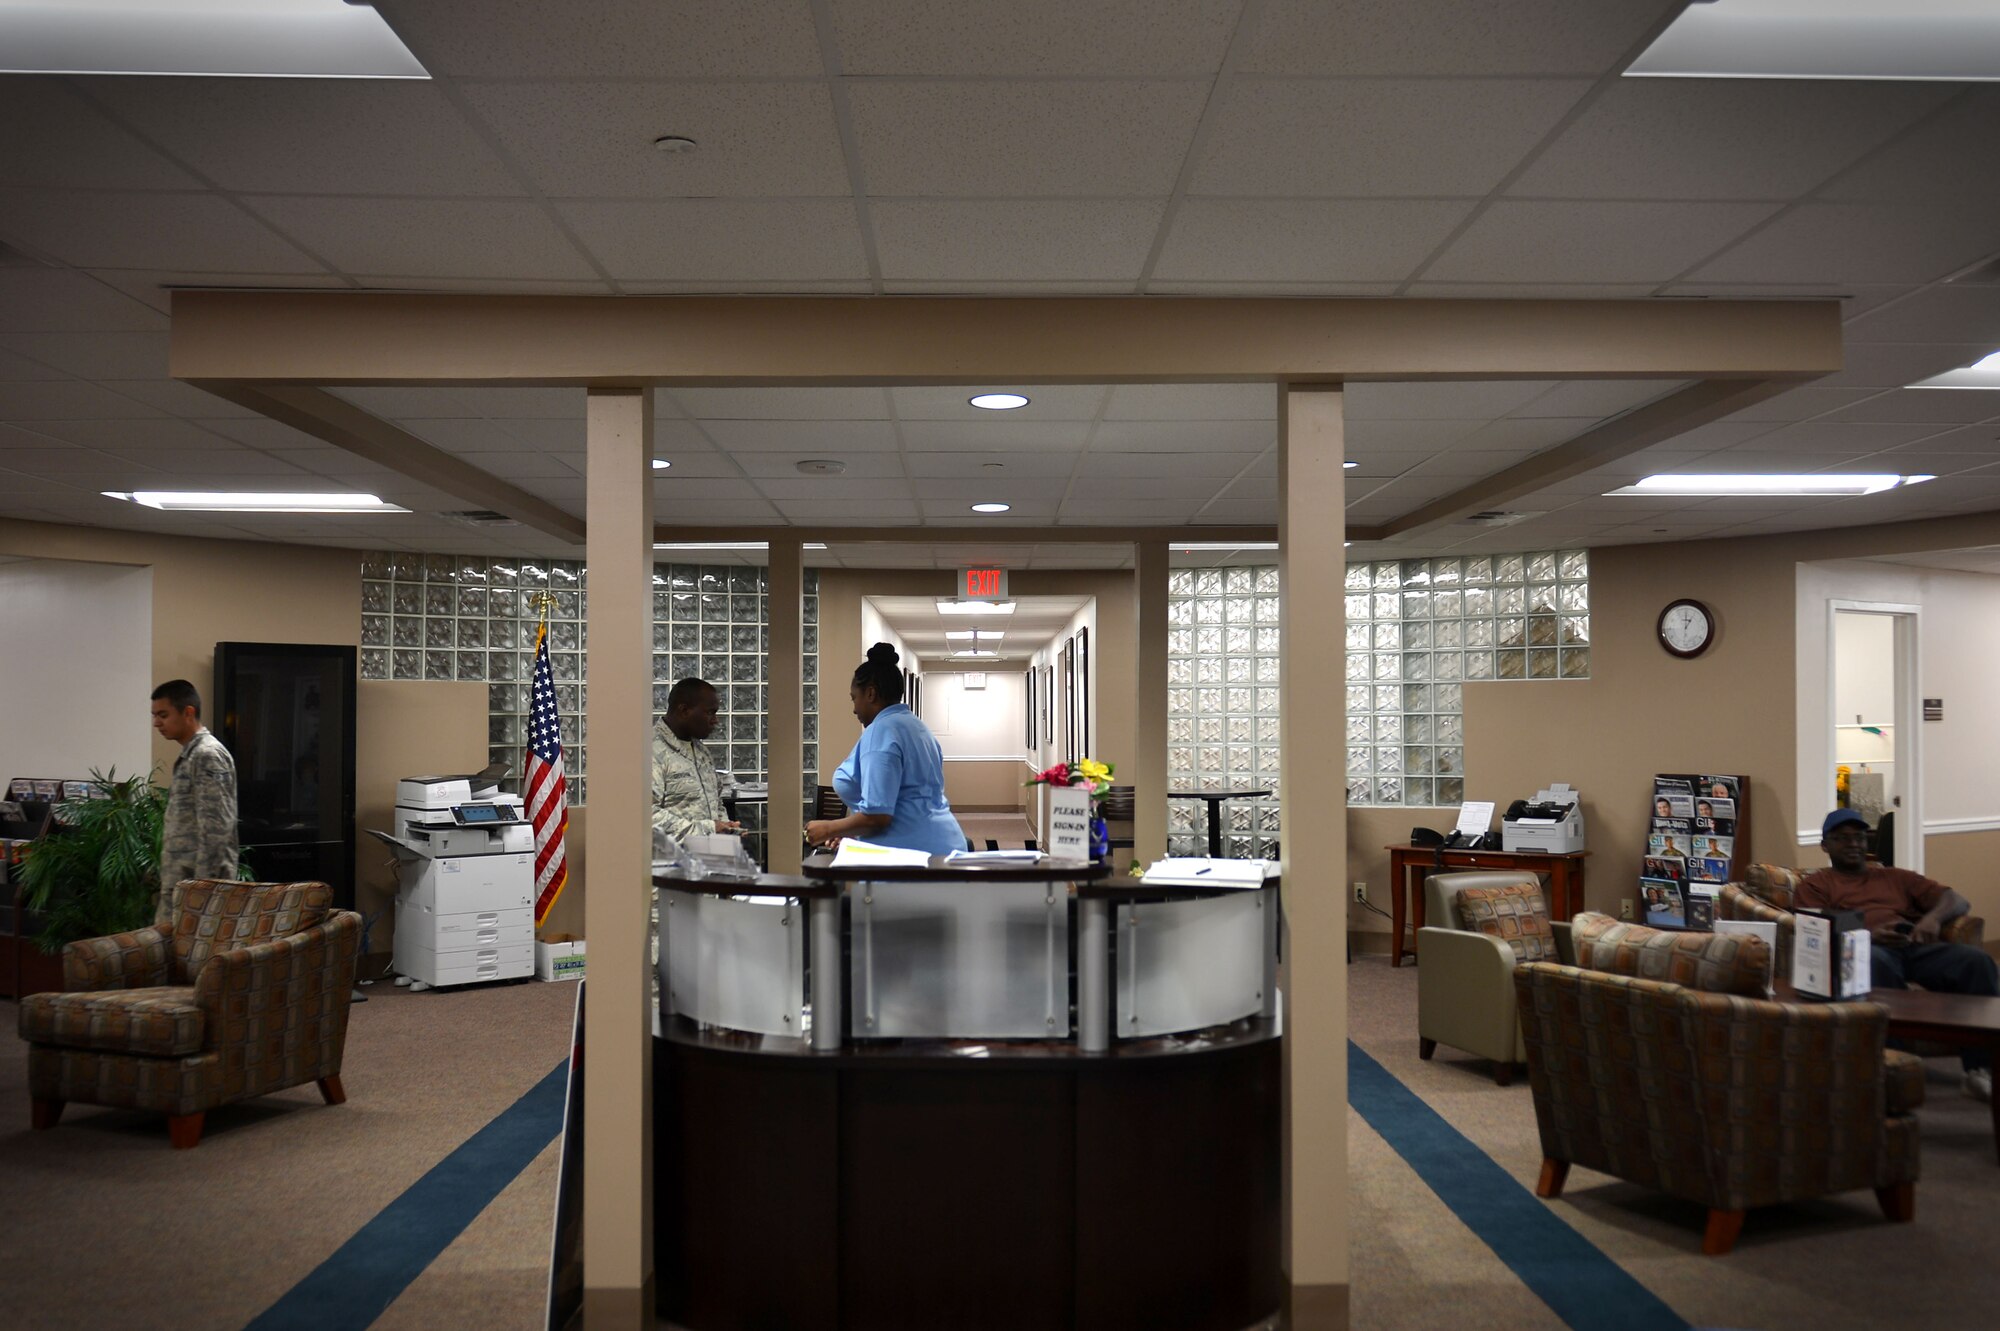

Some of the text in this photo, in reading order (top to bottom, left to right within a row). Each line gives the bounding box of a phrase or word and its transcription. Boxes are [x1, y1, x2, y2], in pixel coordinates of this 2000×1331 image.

[967, 570, 1001, 596] EXIT
[1053, 806, 1086, 816] PLEASE
[1053, 821, 1086, 831] SIGN-IN
[1057, 835, 1081, 846] HERE
